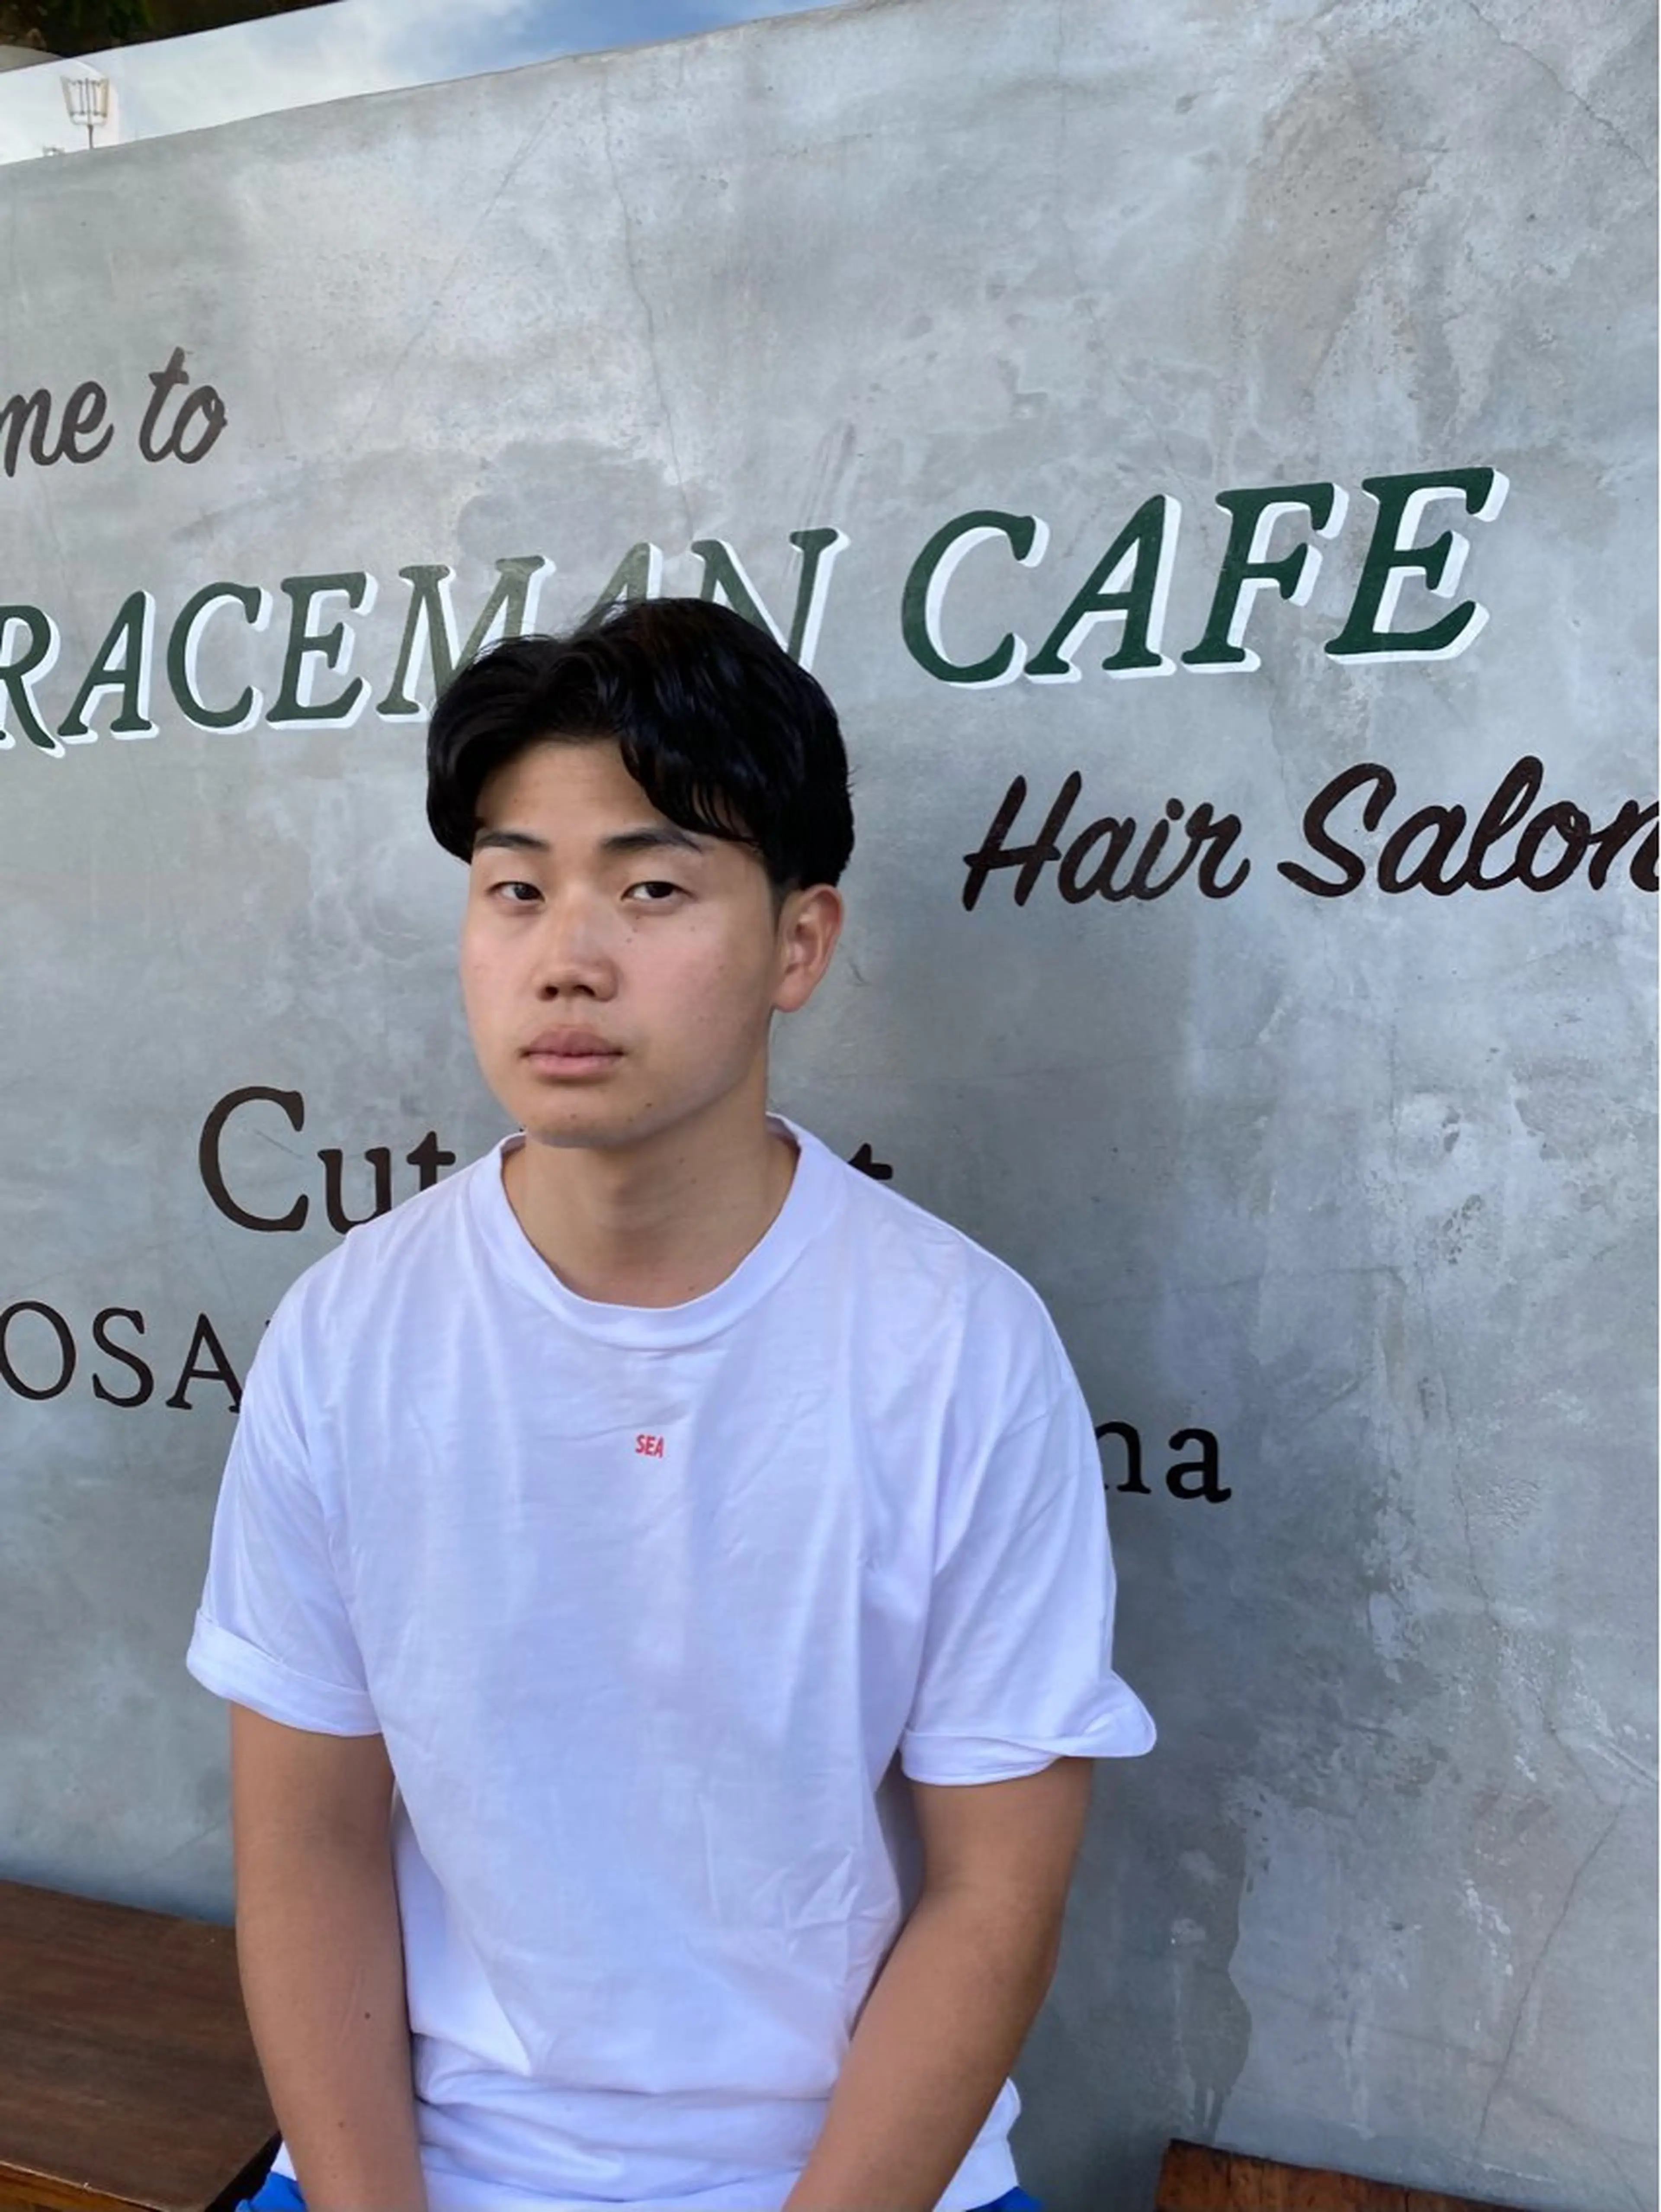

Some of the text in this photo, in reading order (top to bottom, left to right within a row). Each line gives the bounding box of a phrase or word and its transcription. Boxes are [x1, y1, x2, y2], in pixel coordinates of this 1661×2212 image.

[138, 346, 228, 464] to
[901, 467, 1509, 689] CAFE
[963, 755, 1659, 912] Hair Salon
[635, 1434, 664, 1459] SEA
